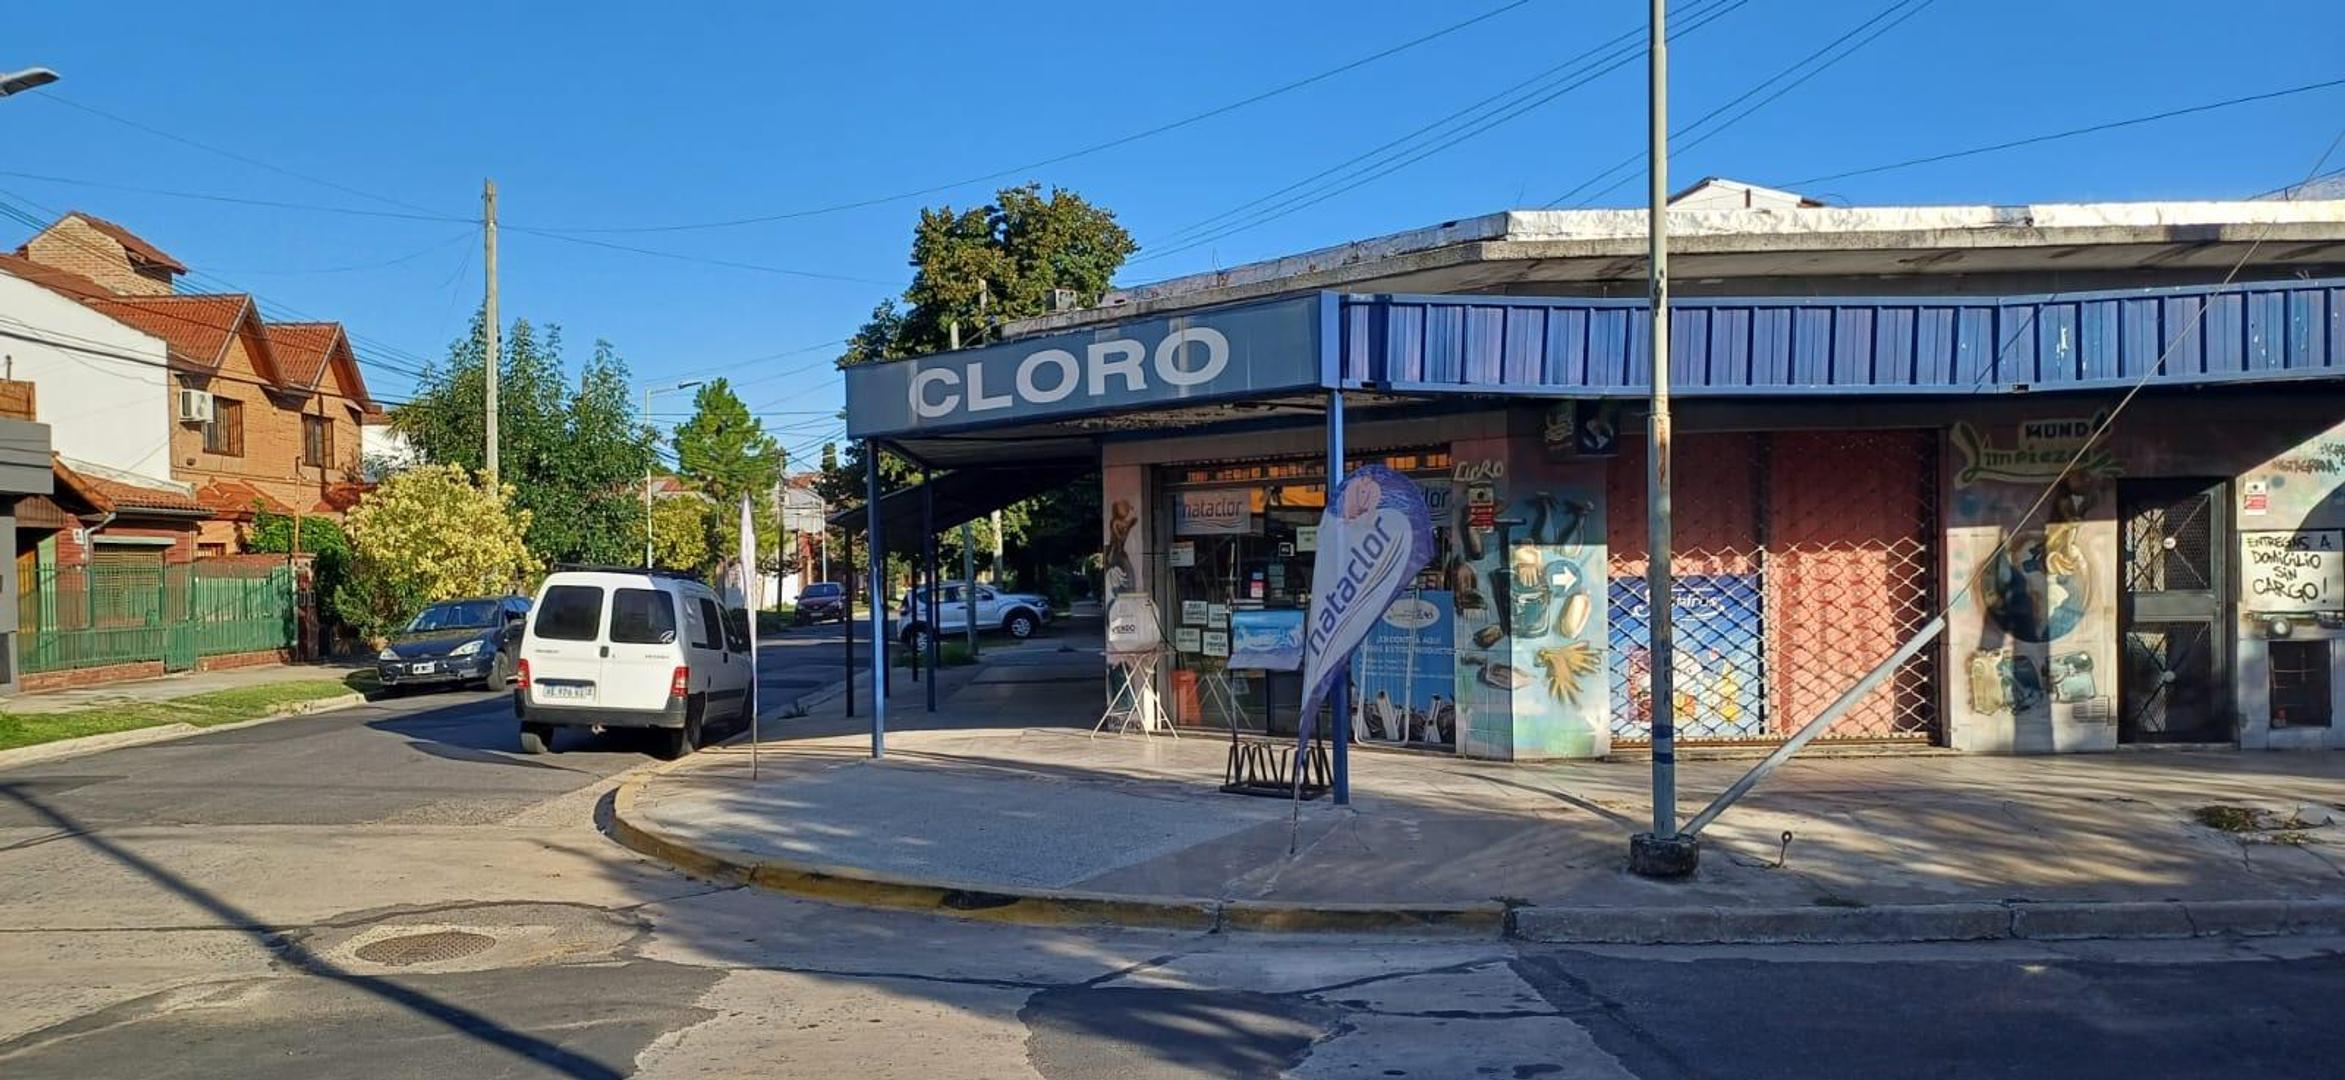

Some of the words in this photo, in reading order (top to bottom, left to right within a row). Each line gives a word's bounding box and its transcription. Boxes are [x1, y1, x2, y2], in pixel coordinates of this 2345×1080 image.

[907, 326, 1231, 418] CLORO
[1182, 499, 1243, 519] nataclor
[2320, 533, 2333, 550] A
[1307, 516, 1392, 657] nataclor
